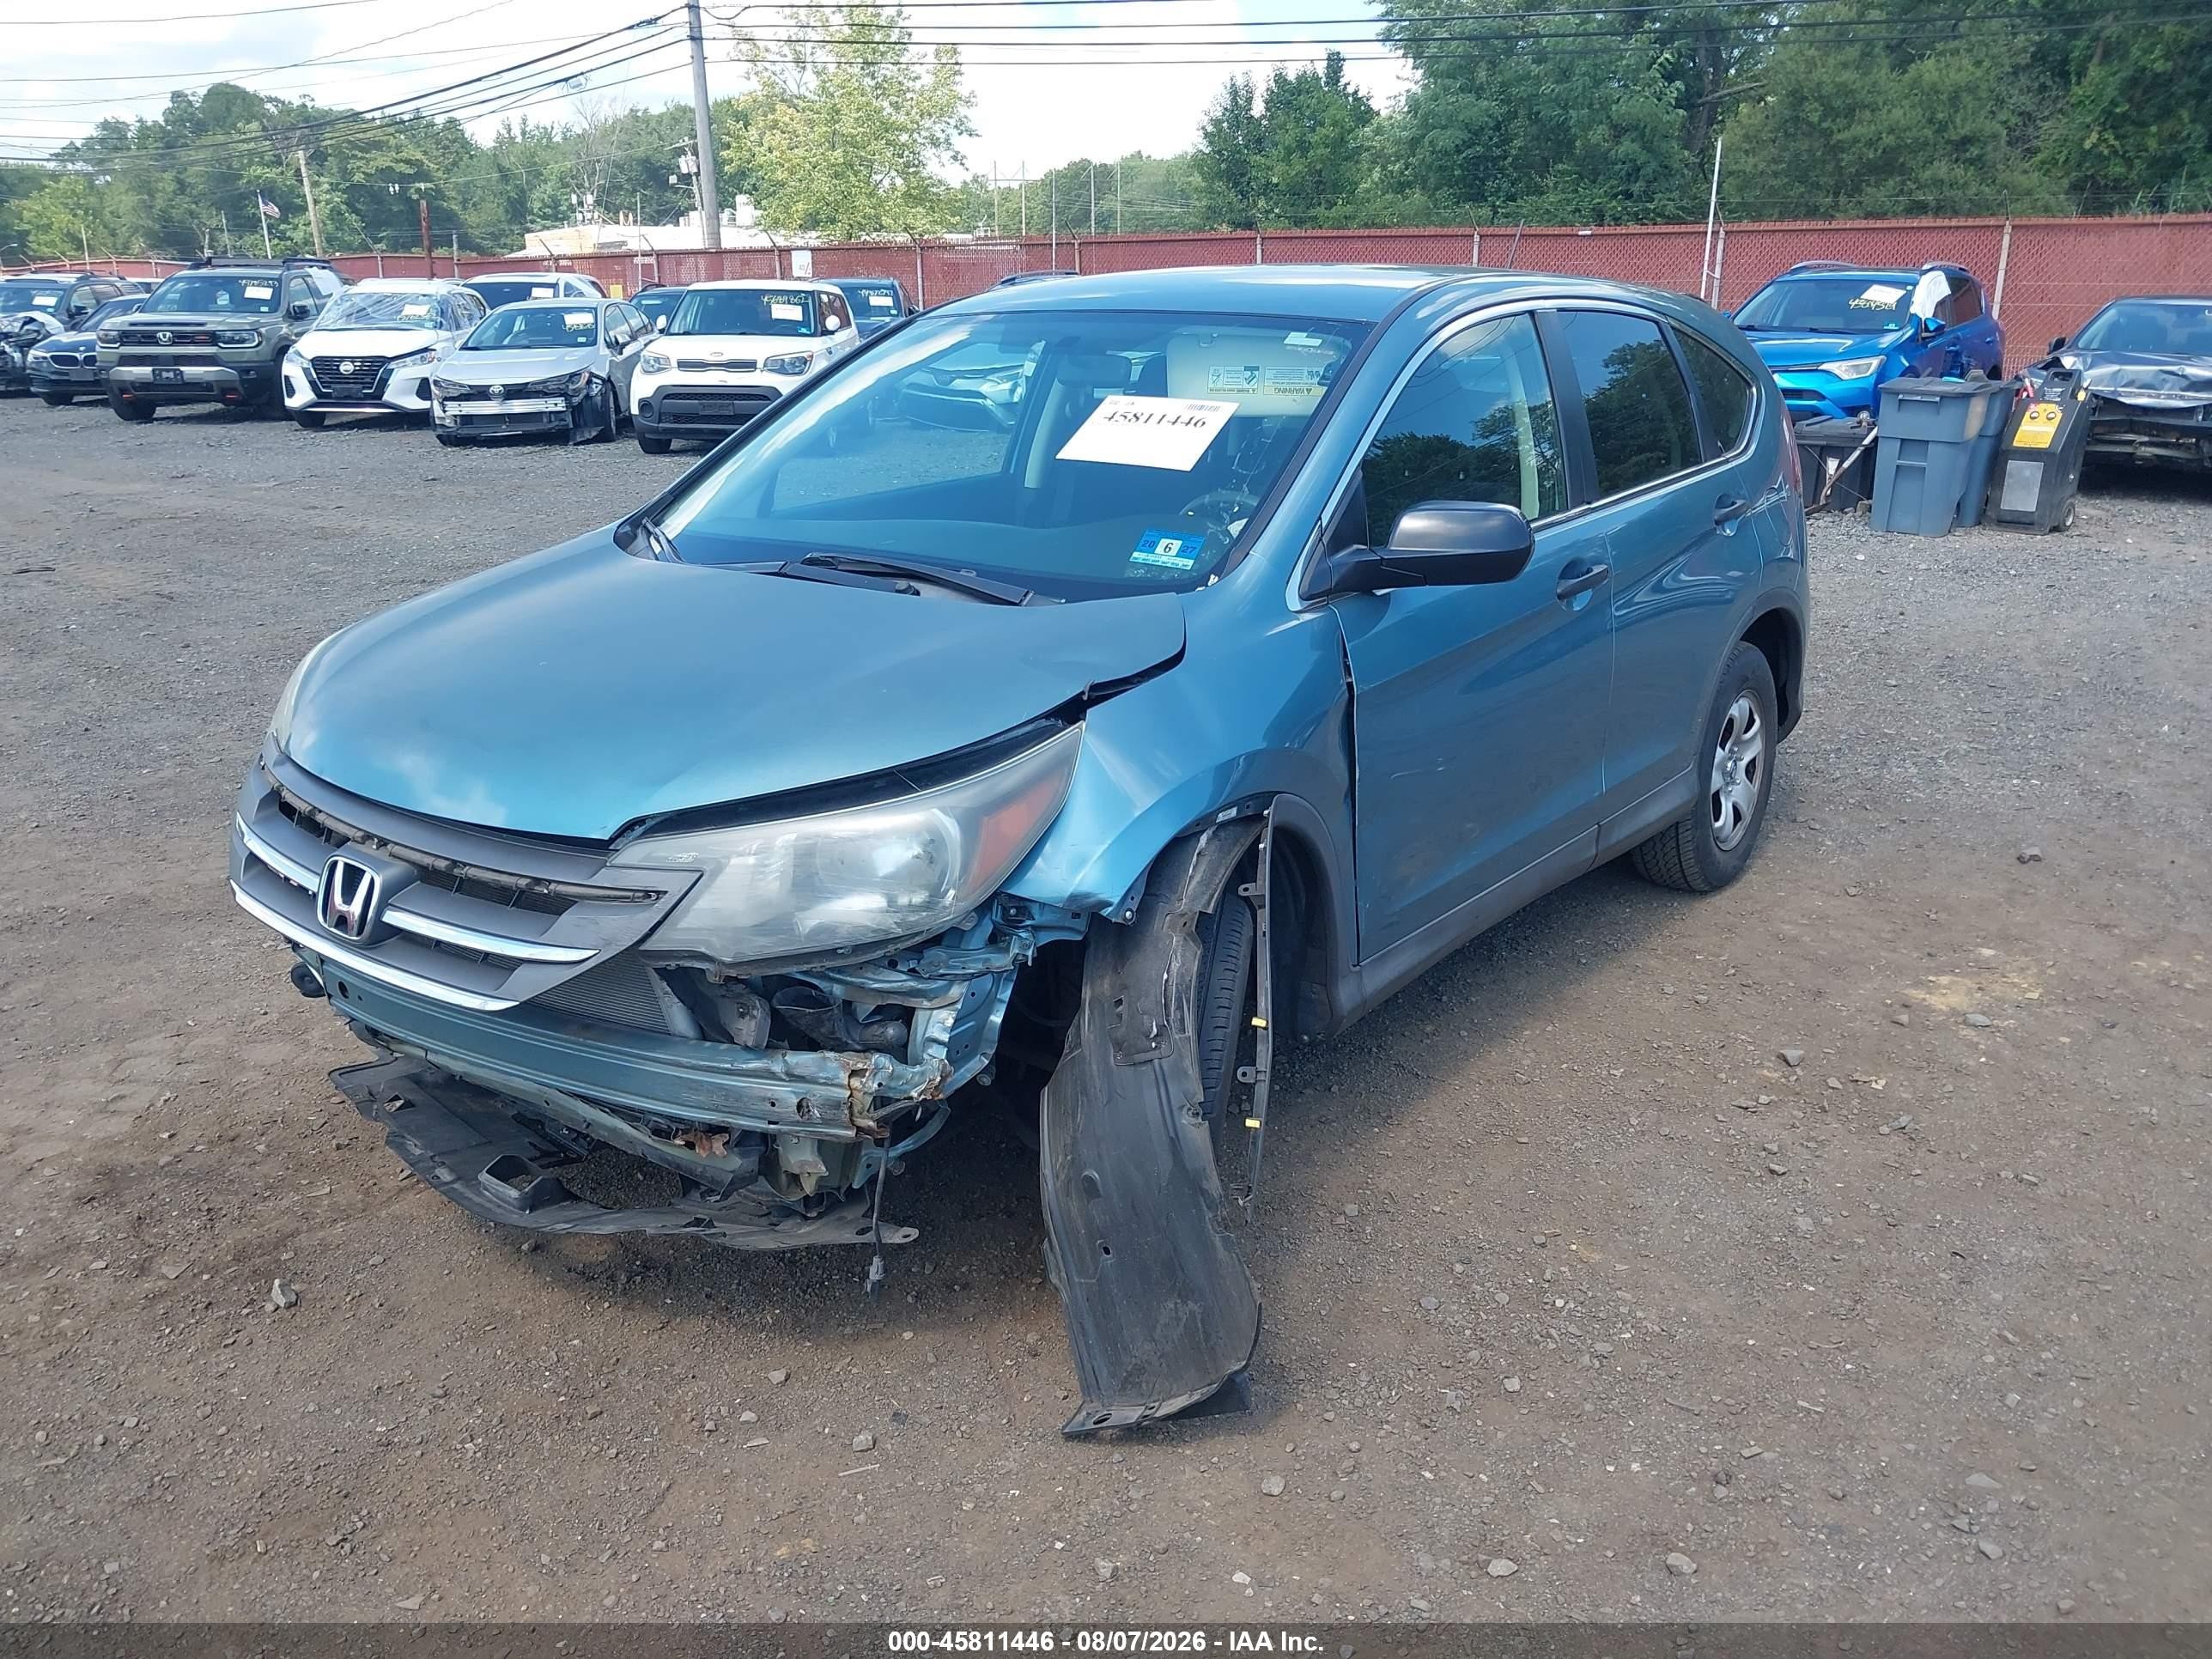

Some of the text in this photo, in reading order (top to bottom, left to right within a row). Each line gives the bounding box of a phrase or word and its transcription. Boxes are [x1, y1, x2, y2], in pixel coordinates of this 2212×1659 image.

[1103, 410, 1207, 428] 45811446
[1141, 539, 1197, 554] 20 6 27
